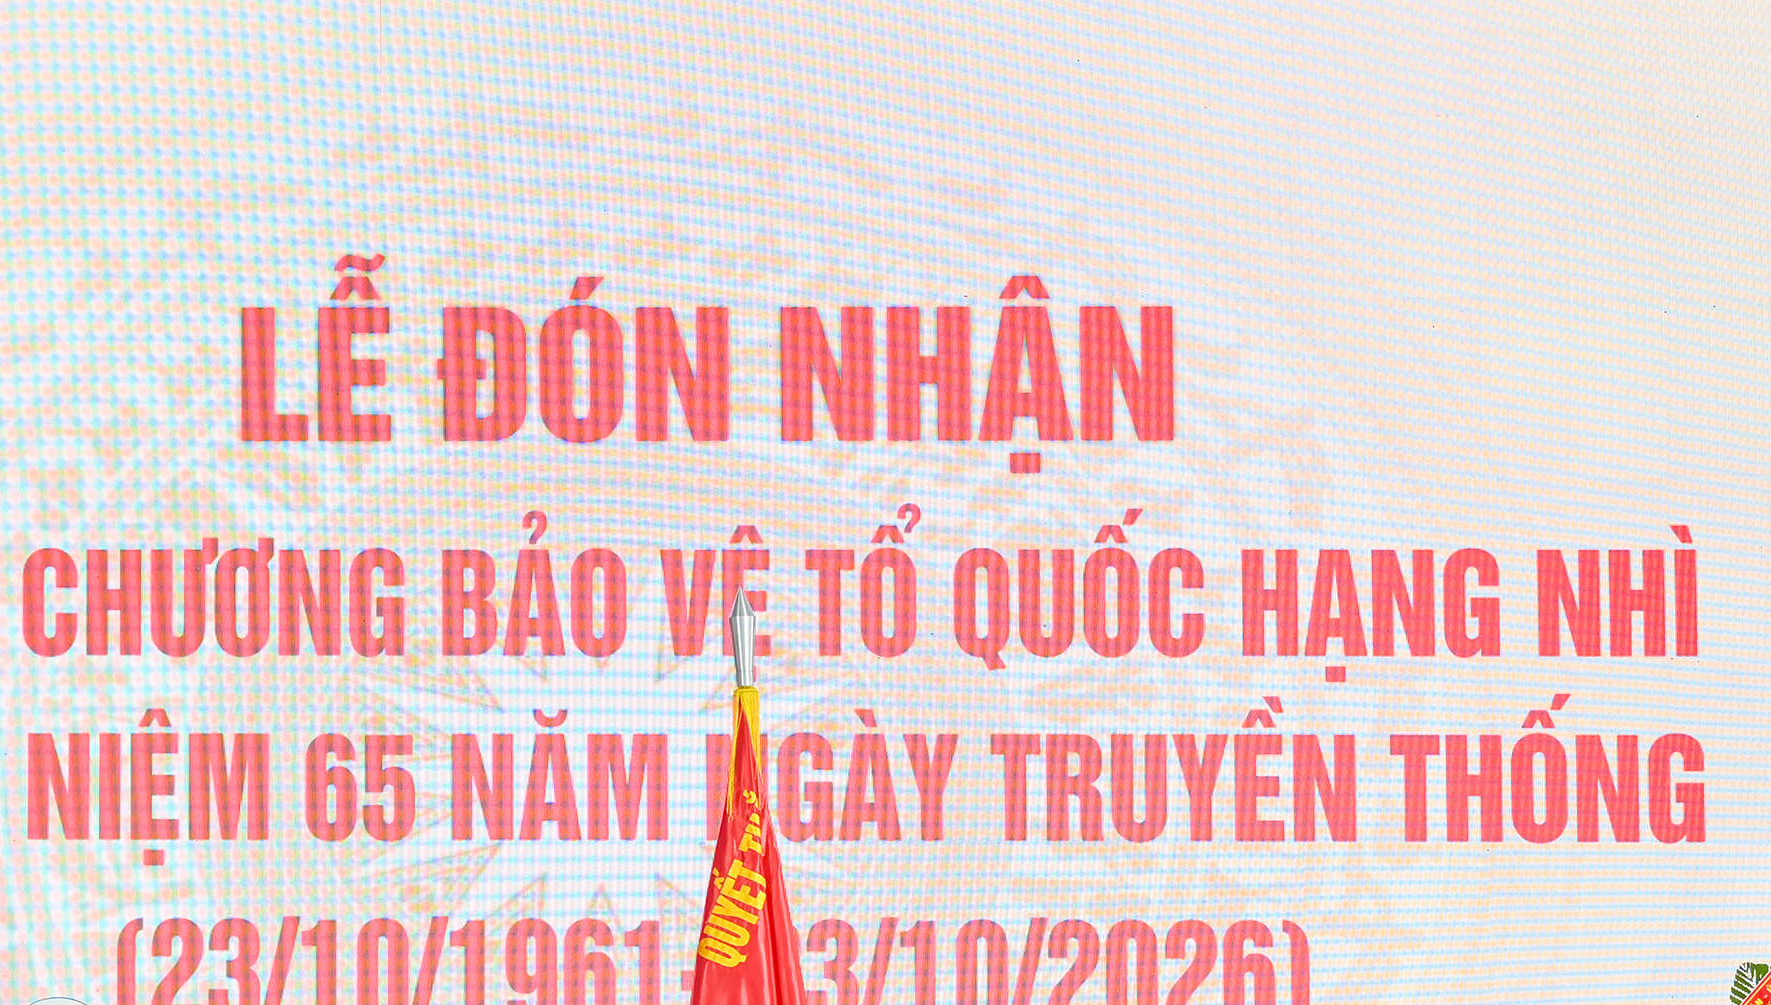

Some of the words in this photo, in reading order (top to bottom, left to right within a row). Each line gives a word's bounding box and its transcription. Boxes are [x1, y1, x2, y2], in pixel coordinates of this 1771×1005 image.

[240, 255, 391, 443] LỄ
[436, 276, 731, 443] ĐÓN
[781, 276, 1175, 474] NHẬN
[22, 537, 405, 658] CHƯƠNG
[442, 511, 626, 656] BẢO
[805, 505, 921, 658] TỔ
[954, 509, 1205, 669] QUỐC
[1242, 548, 1501, 682] HẠNG
[1537, 525, 1698, 657] NHÌ
[29, 709, 269, 865] NIỆM
[306, 735, 415, 841] 65
[454, 713, 667, 839] NĂM
[992, 697, 1357, 842] TRUYỀN
[1390, 693, 1706, 844] THỐNG
[697, 859, 766, 968] QUYẾT
